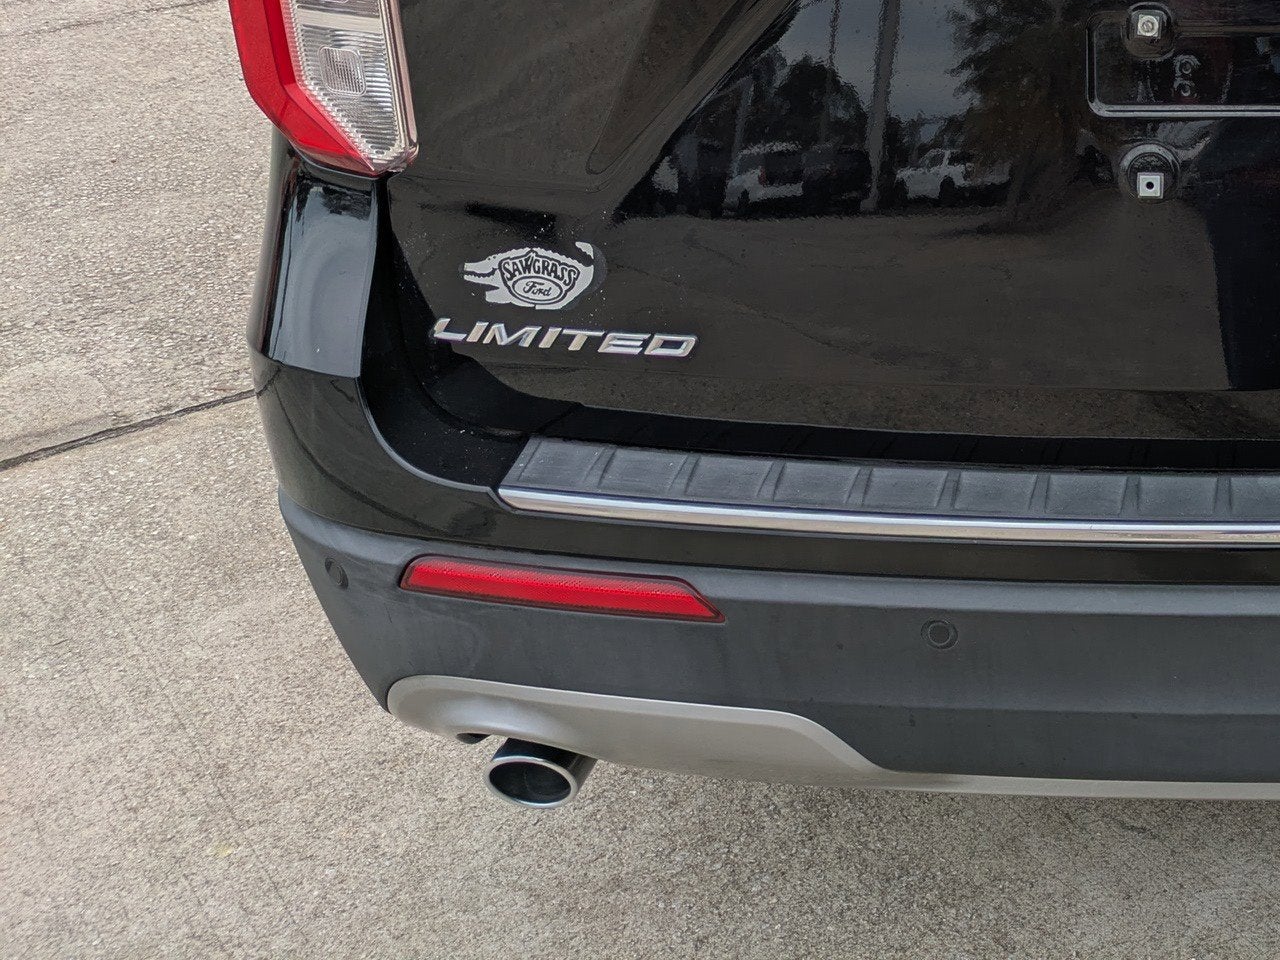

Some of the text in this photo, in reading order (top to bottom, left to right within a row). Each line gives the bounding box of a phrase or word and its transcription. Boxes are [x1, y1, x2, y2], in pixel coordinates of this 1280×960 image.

[502, 255, 576, 286] SAWGRASS
[523, 280, 552, 297] Ford
[433, 318, 698, 357] LIMITED
